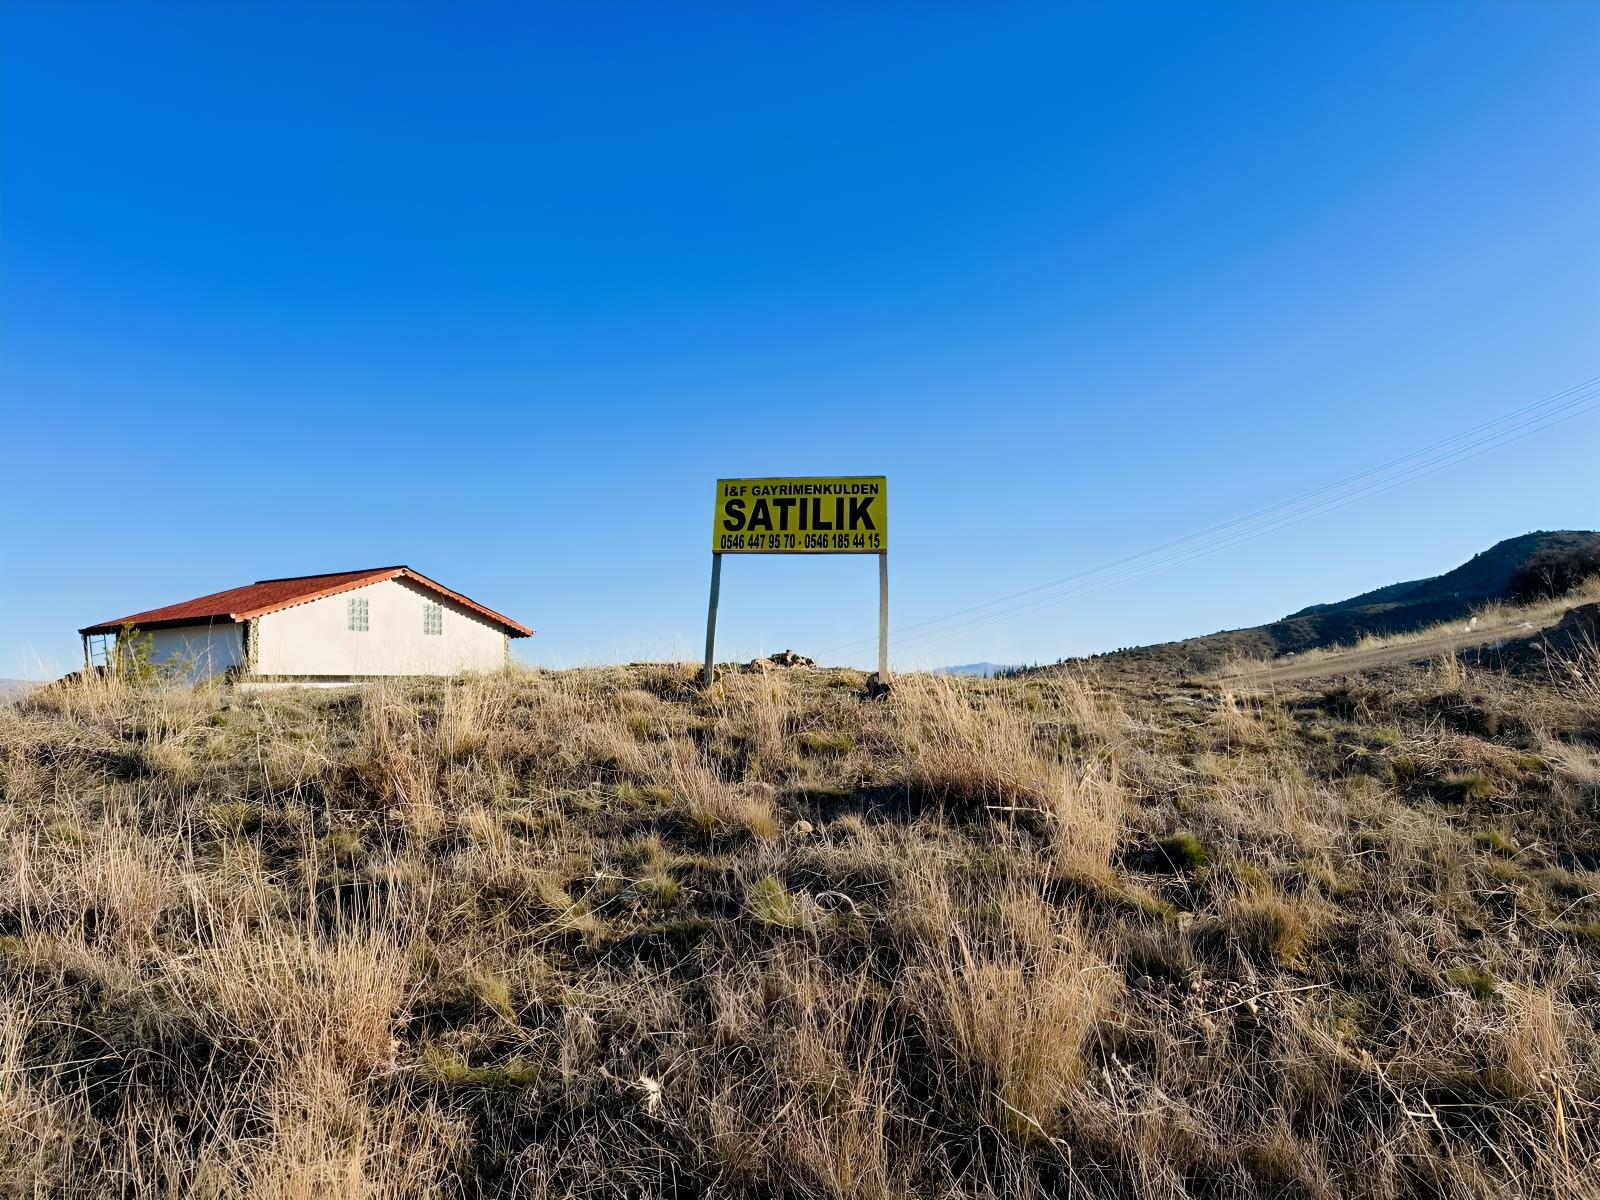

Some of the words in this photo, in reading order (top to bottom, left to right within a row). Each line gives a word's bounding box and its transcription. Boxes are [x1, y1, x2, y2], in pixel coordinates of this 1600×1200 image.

[725, 483, 747, 496] İ&F
[752, 482, 878, 496] GAYRİMENKULDEN
[723, 497, 876, 531] SATILIK
[721, 535, 744, 549] 0546
[748, 535, 765, 549] 447
[769, 534, 780, 549] 95
[784, 534, 796, 549] 70
[804, 534, 828, 549] 0546
[832, 533, 850, 548] 185
[853, 533, 865, 548] 44
[868, 533, 880, 548] 15
